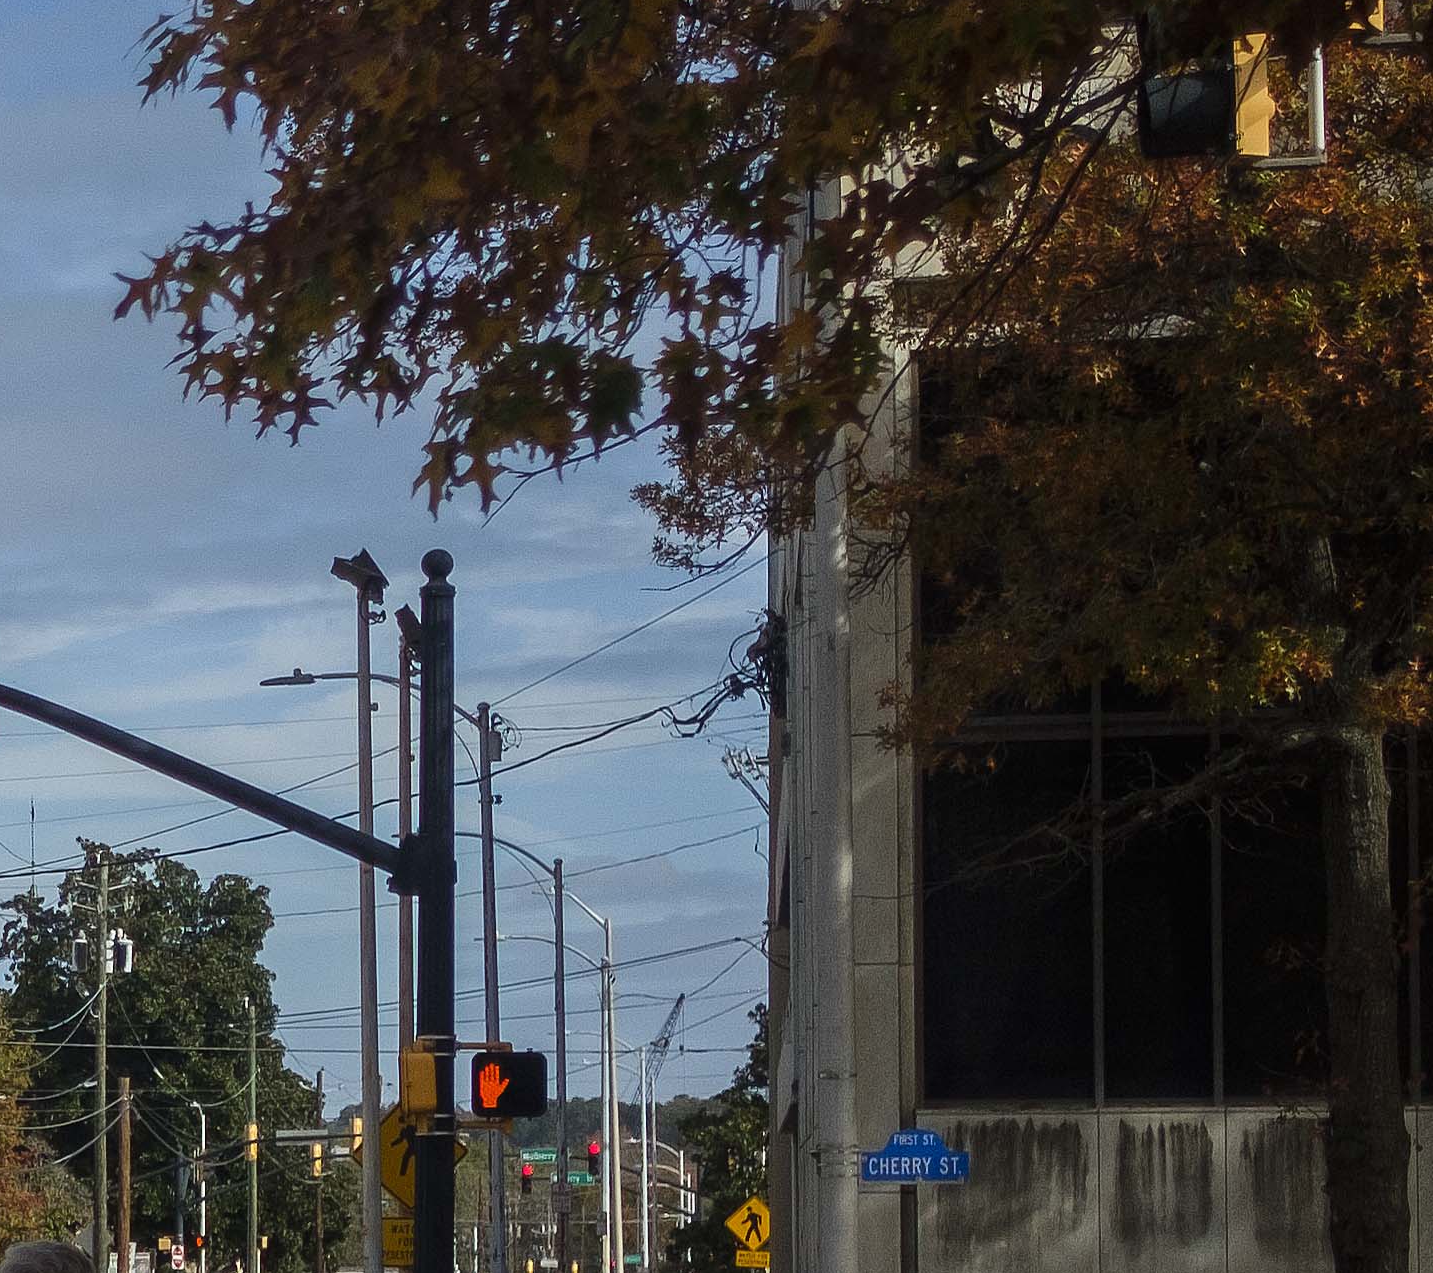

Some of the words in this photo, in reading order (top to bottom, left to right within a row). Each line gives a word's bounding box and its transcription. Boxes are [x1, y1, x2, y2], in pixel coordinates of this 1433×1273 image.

[893, 1134, 918, 1146] FIRST
[923, 1134, 936, 1146] ST.
[869, 1157, 932, 1175] CHERRY
[939, 1157, 962, 1175] ST.
